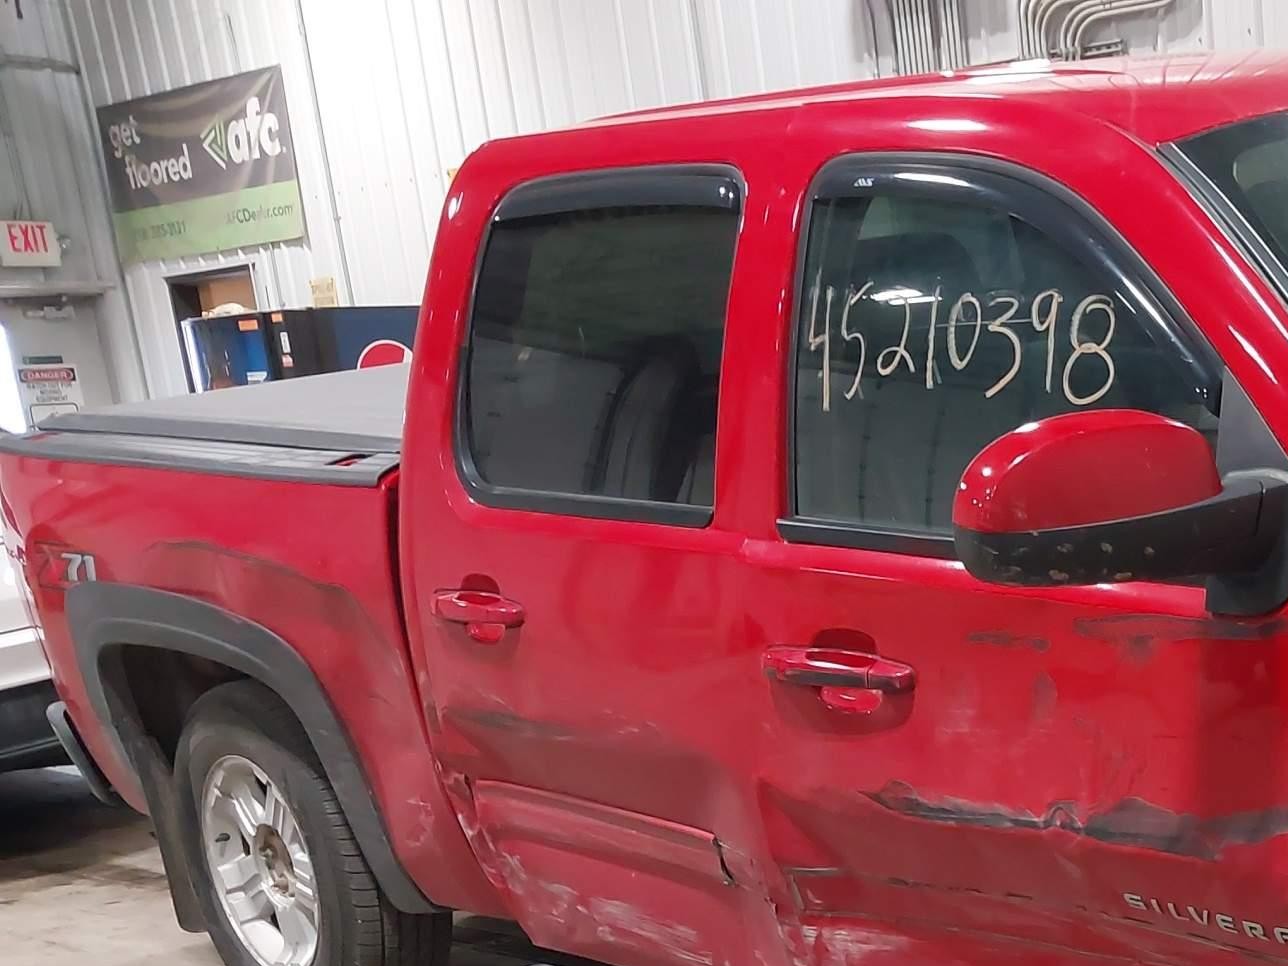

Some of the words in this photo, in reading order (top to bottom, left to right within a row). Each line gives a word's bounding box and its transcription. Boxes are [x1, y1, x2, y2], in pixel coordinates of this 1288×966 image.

[108, 115, 140, 158] get
[125, 144, 193, 190] floored
[7, 223, 50, 254] EXIT
[808, 267, 1116, 413] 45210398
[26, 370, 69, 381] DANGER
